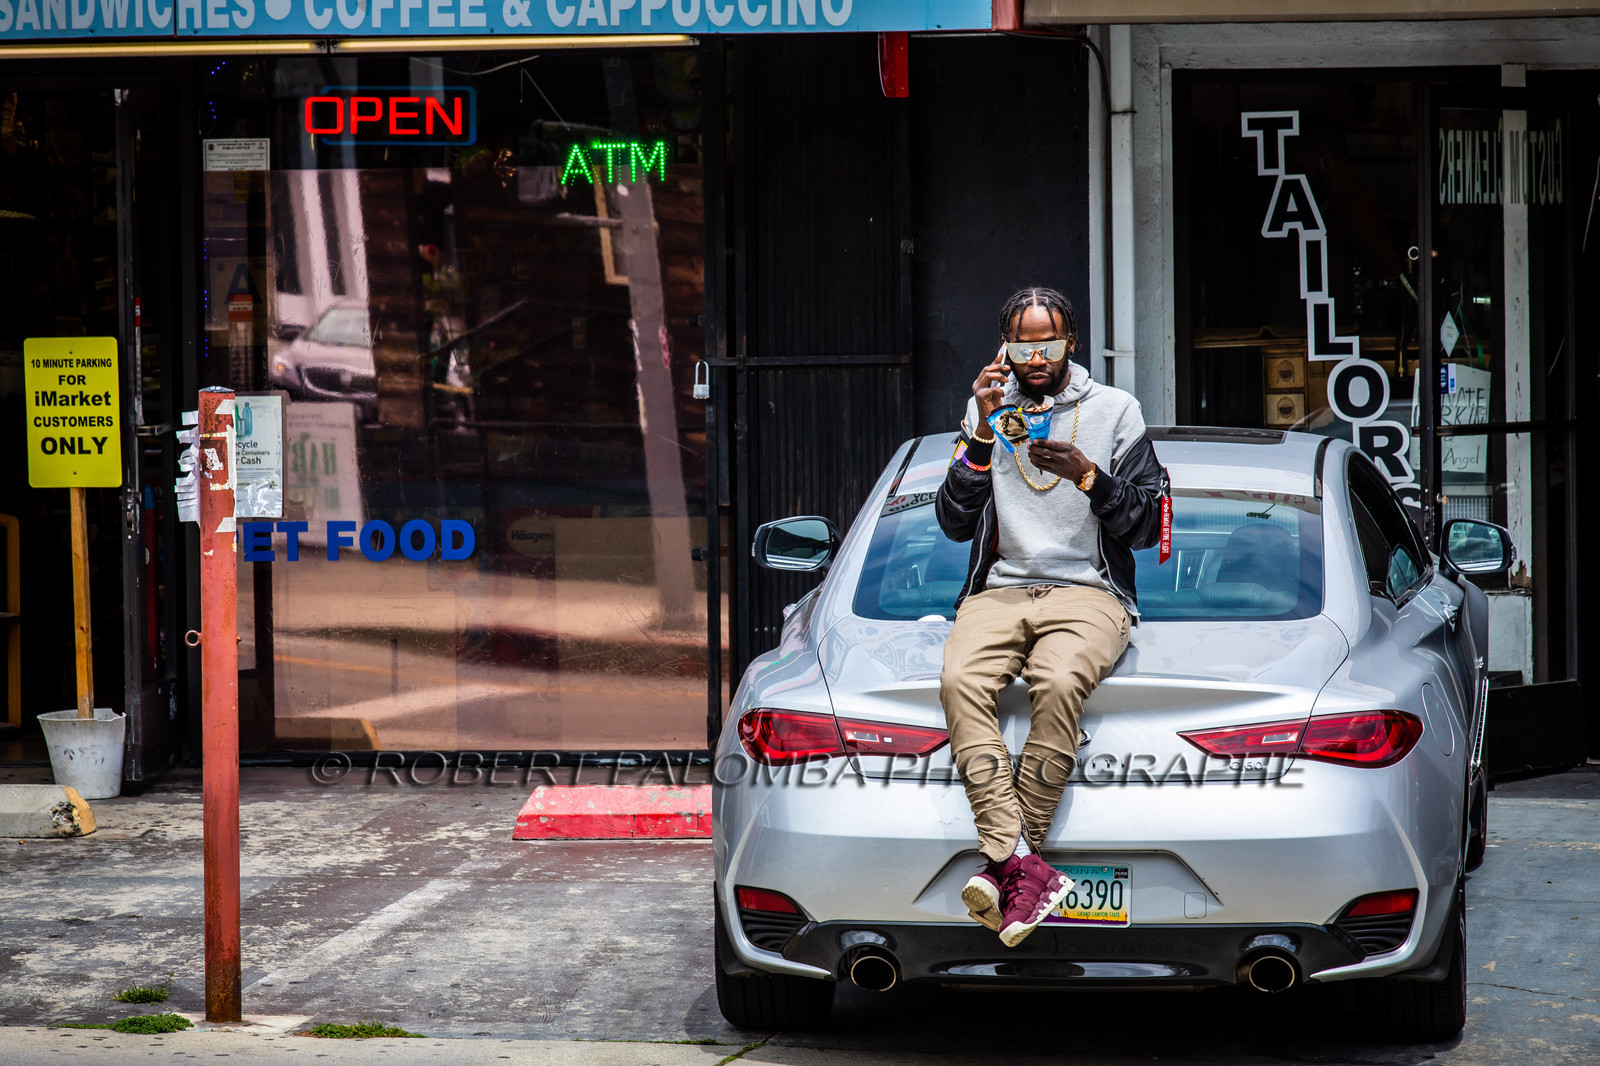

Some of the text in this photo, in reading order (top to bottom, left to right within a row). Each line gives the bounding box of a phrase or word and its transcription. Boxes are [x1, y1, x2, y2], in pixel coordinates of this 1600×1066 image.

[304, 0, 487, 30] COFFEE
[503, 0, 533, 28] &
[548, 0, 852, 28] CAPPUCCINO
[304, 96, 462, 135] OPEN
[560, 141, 667, 185] ATM
[31, 358, 112, 368] 10 MINUTE PARKING
[58, 375, 87, 385] FOR
[34, 391, 111, 407] iMarket
[33, 416, 114, 427] CUSTOMERS
[40, 436, 108, 455] ONLY
[240, 456, 261, 465] Cash
[236, 519, 476, 562] ET FOOD
[511, 529, 555, 544] Häagen-
[1060, 878, 1123, 911] 6390
